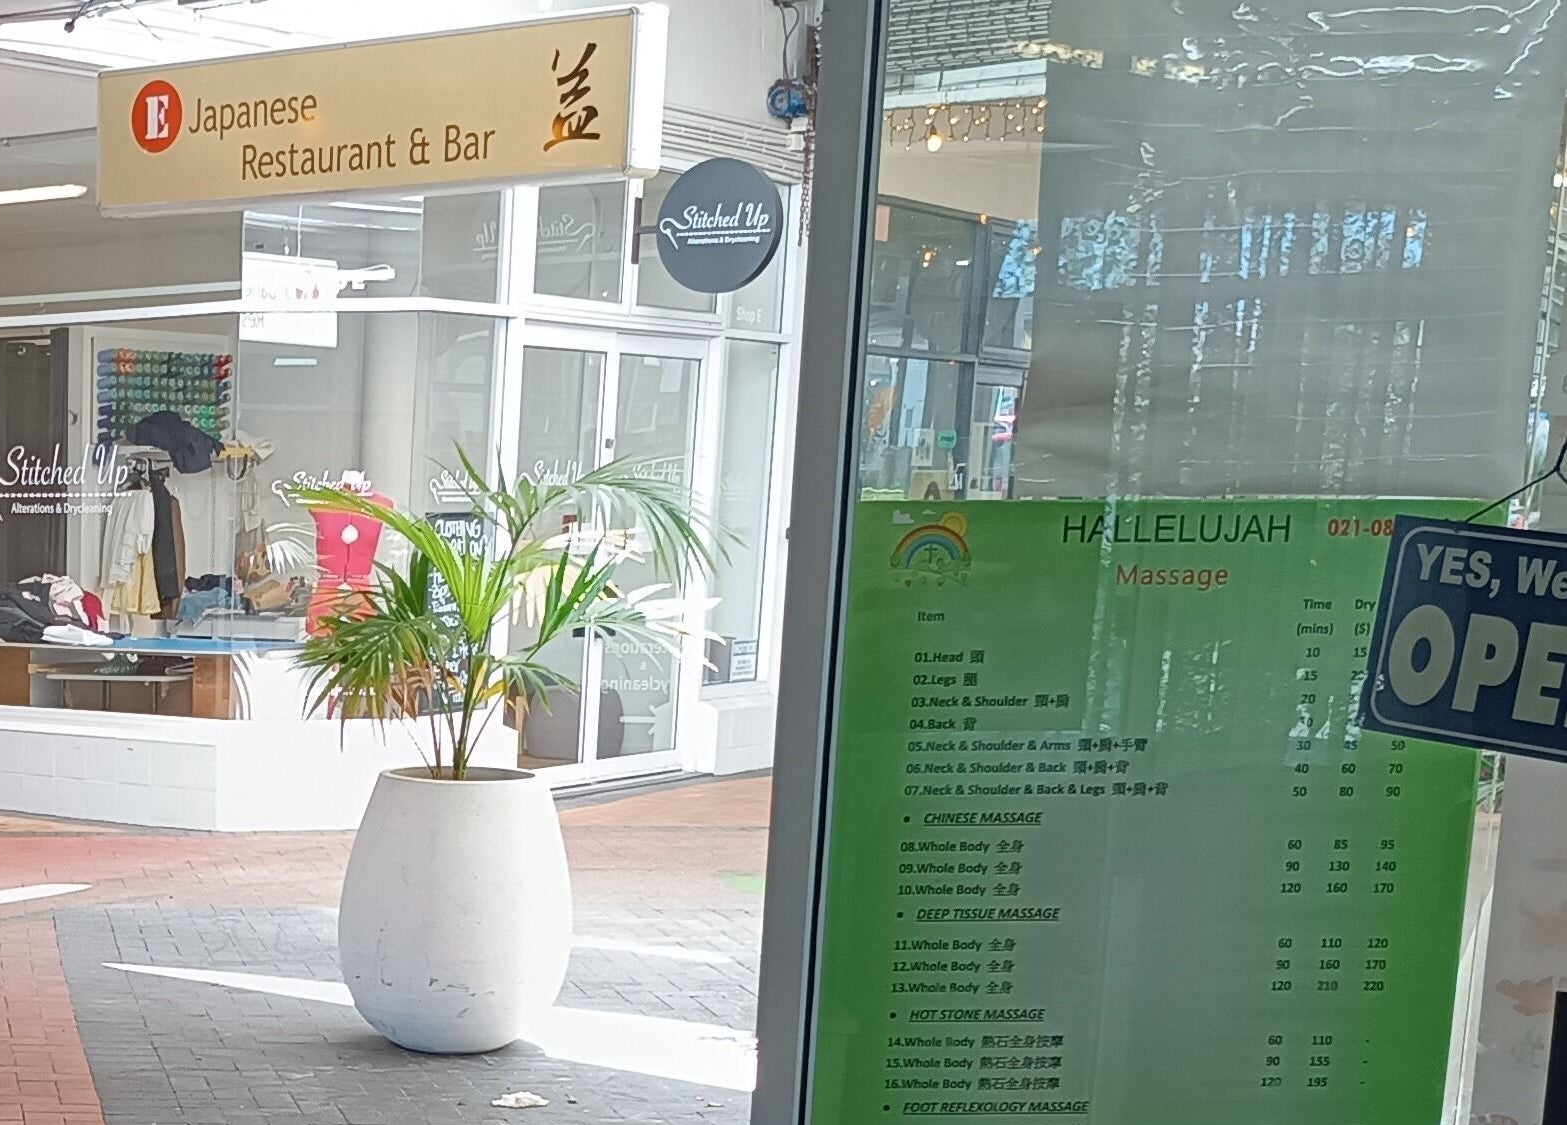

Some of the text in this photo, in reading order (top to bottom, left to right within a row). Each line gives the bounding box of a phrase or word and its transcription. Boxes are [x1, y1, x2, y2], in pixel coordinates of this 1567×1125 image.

[188, 94, 317, 140] Japanese
[242, 124, 496, 180] Restaurant & Bar
[678, 202, 770, 233] Stitched Up
[736, 306, 756, 324] Shop
[0, 443, 129, 496] Stitched Up
[11, 502, 113, 516] Alterations & Drycleaning
[1116, 564, 1229, 591] Massage
[1417, 543, 1567, 600] YES, We
[1303, 599, 1376, 612] Time Dry
[917, 611, 945, 623] Item
[1296, 622, 1371, 636] (mins) ($)
[914, 652, 964, 665] 01.Head
[1306, 647, 1321, 658] 10
[1388, 604, 1567, 728] OPE
[913, 674, 957, 688] 02.Legs
[1303, 670, 1318, 681] 15
[910, 696, 958, 708] 03.Neck
[974, 695, 1029, 708] Shoulder
[1301, 694, 1316, 704] 20
[909, 718, 956, 730] 04.Back
[907, 740, 957, 752] 05.Neck
[972, 739, 1028, 751] Shoulder
[1040, 740, 1072, 751] Arms
[1297, 740, 1311, 750] 30
[1391, 740, 1406, 750] 50
[906, 762, 954, 774] 06.Neck
[969, 761, 1023, 774] Shoulder
[1038, 761, 1067, 773] Back
[1294, 763, 1309, 774] 40
[1341, 763, 1356, 774] 60
[1389, 763, 1403, 774] 70
[904, 785, 952, 796] 07.Neck
[968, 783, 1022, 796] Shoulder
[1036, 783, 1065, 795] Back
[1080, 783, 1106, 797] Legs
[1292, 786, 1307, 797] 50
[1339, 786, 1354, 797] 80
[1386, 786, 1401, 797] 90
[923, 811, 1044, 825] CHINESE MASSAGE
[900, 840, 990, 854] 08.Whole Body
[898, 862, 988, 876] 09.Whole Body
[897, 883, 986, 897] 10.Whole Body
[916, 907, 1061, 920] DEEP TISSUE MASSAGE
[894, 939, 982, 953] 11.Whole Body
[892, 960, 981, 974] 12.Whole Body
[891, 982, 980, 996] 13.Whole Body
[910, 1008, 1045, 1021] HOT STONE MASSAGE
[887, 1036, 975, 1049] 14.Whole Body
[886, 1058, 973, 1071] 15.Whole Body
[884, 1079, 972, 1092] 16.Whole Body
[903, 1101, 1090, 1113] FOOT REFLEXOLOGY MASSAGE
